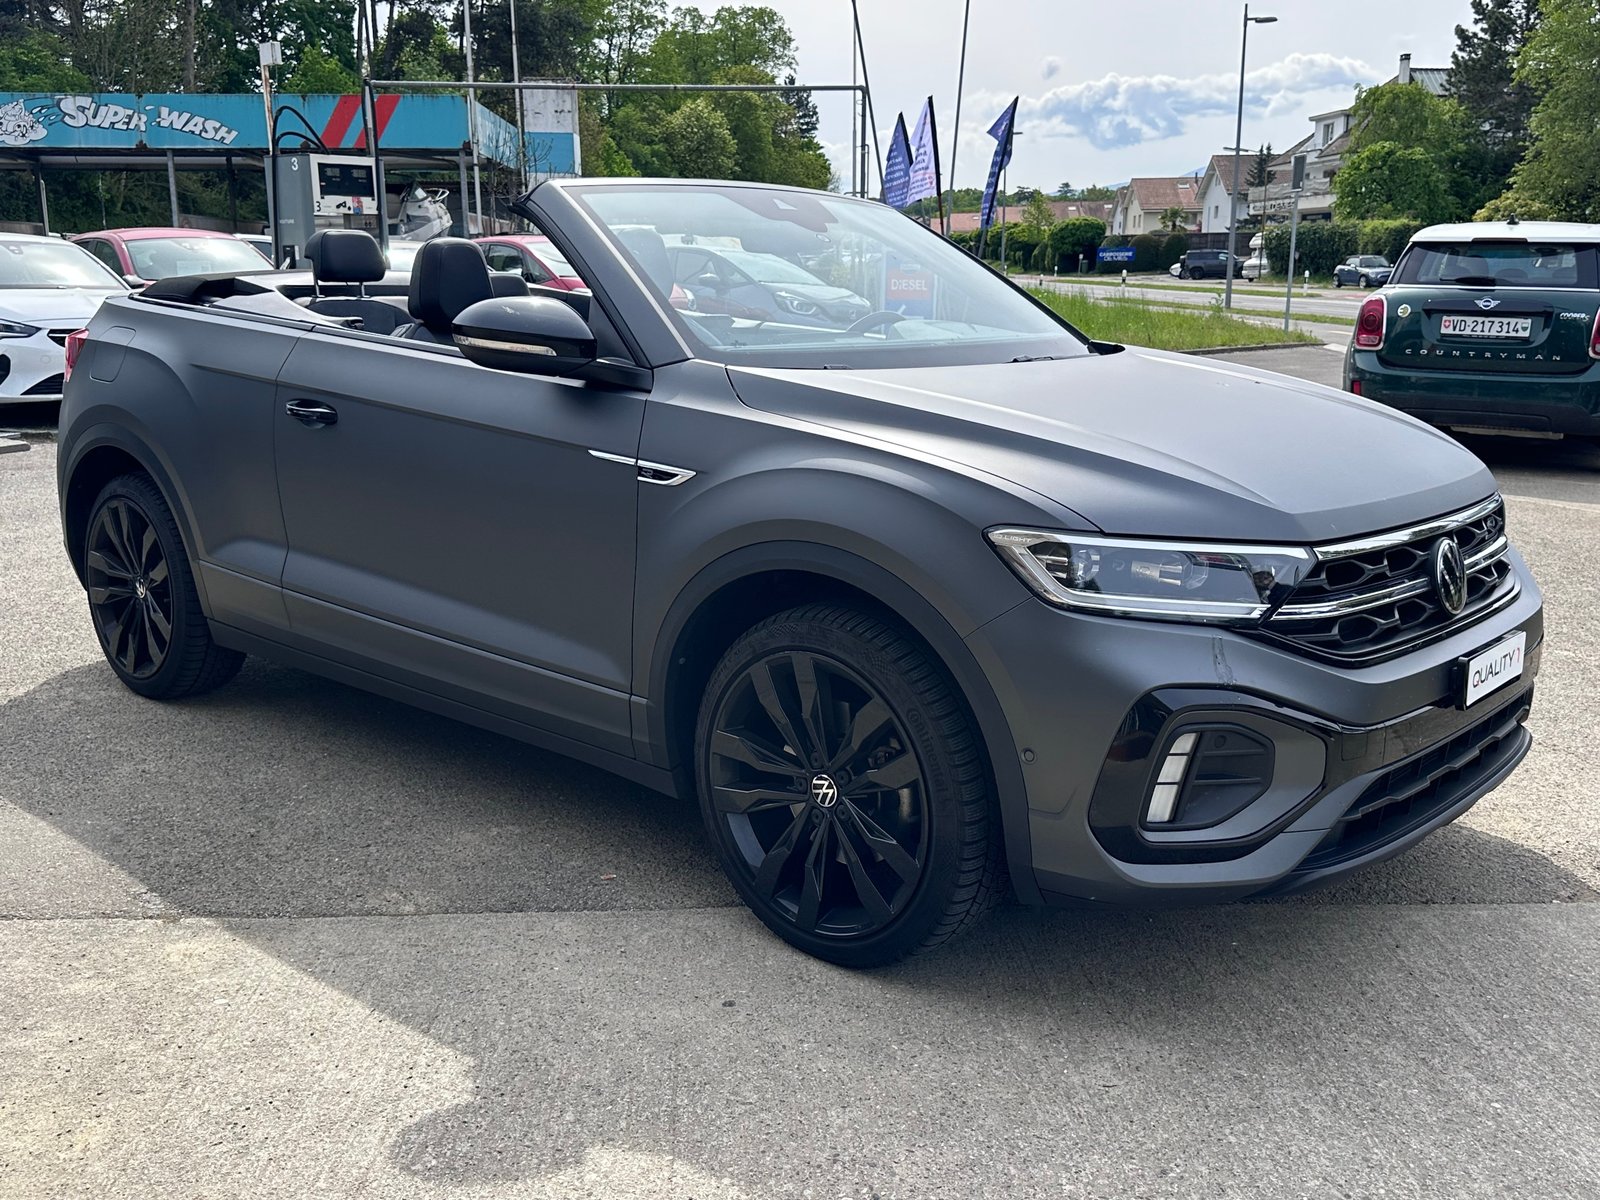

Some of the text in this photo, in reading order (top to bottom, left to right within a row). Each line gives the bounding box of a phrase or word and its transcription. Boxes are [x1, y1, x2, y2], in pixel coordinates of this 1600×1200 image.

[56, 95, 239, 145] SUPER WASH
[291, 157, 299, 171] 3
[315, 201, 321, 212] 3
[1405, 348, 1561, 361] COUNTRYMAN
